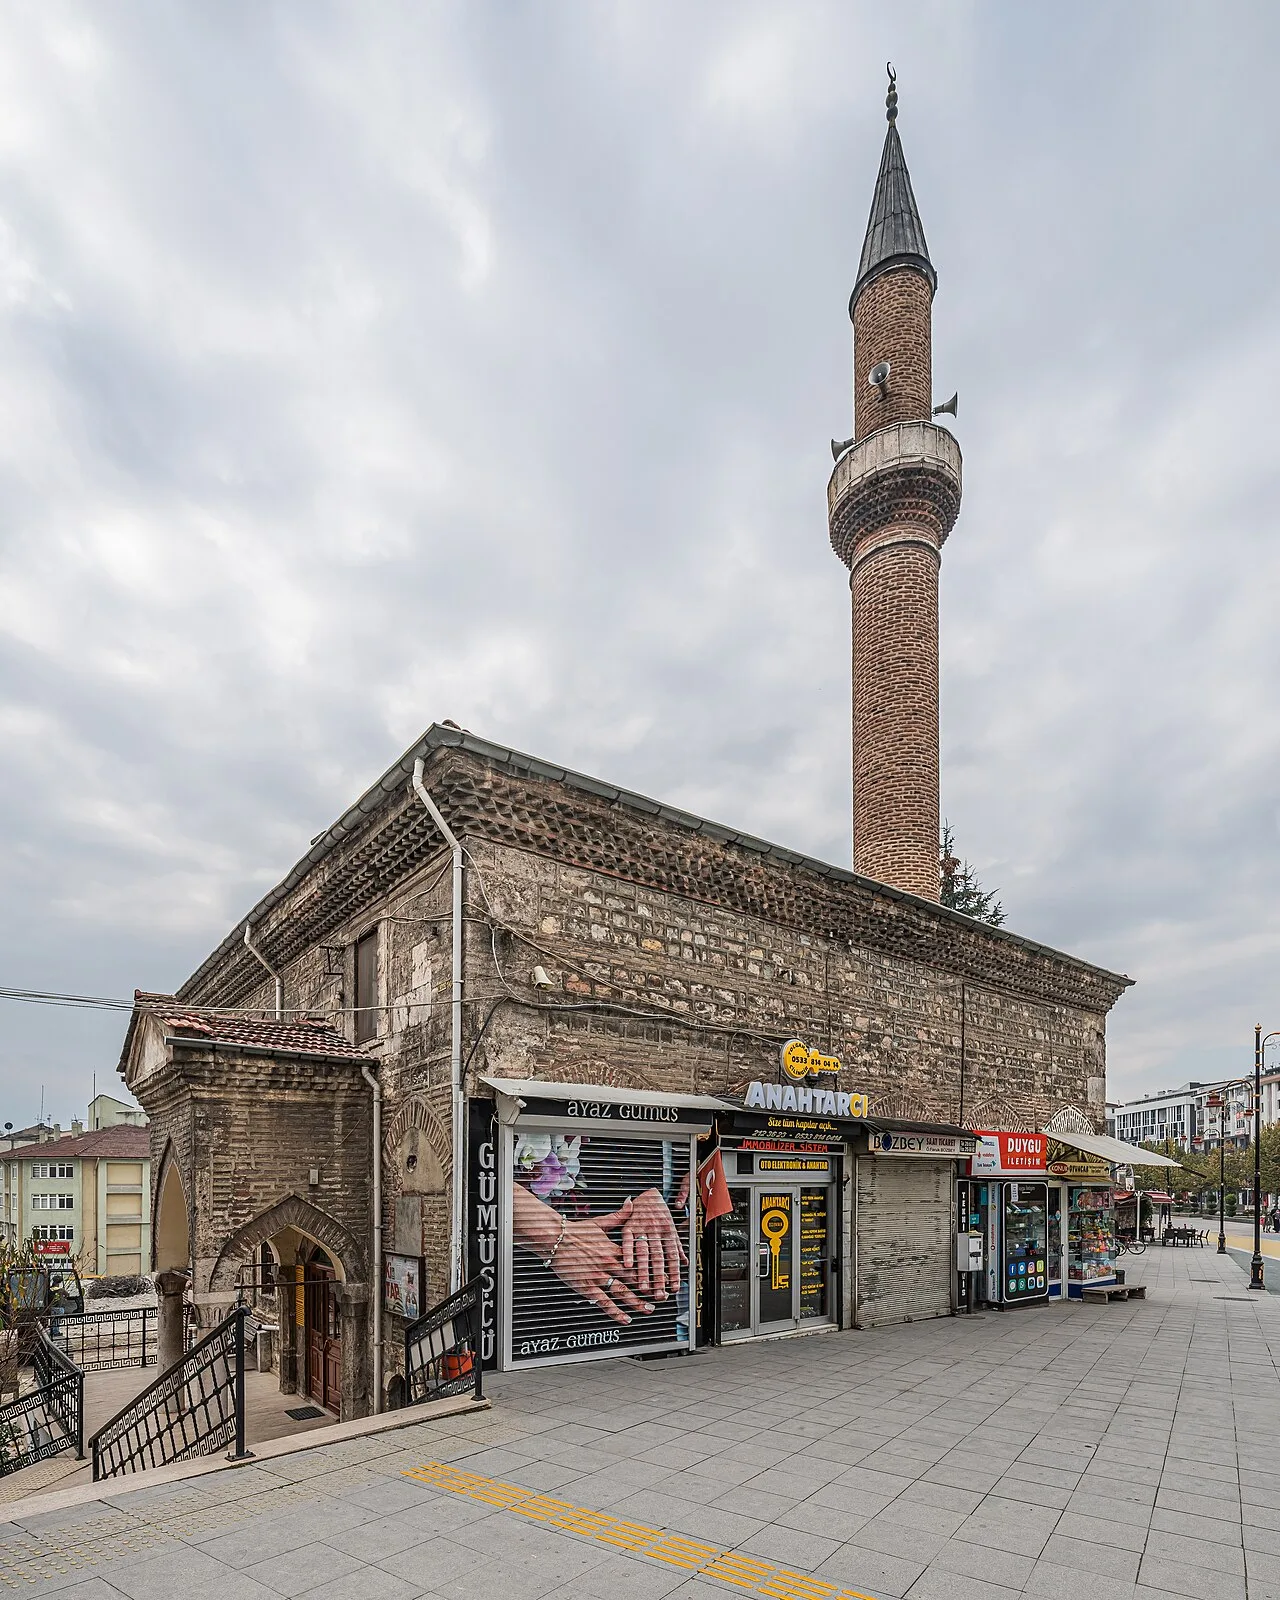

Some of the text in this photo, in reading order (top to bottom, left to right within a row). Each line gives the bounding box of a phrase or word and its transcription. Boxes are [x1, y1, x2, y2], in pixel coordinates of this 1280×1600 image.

[792, 1056, 807, 1064] 0533
[811, 1058, 821, 1066] 814
[744, 1081, 868, 1118] ANAHTARCI
[1007, 1137, 1041, 1154] DUYGU
[760, 1160, 772, 1169] OTO
[807, 1161, 828, 1170] ANAHTAR
[1007, 1155, 1041, 1167] İLETİŞİM
[762, 1197, 790, 1211] ANAHTARCI
